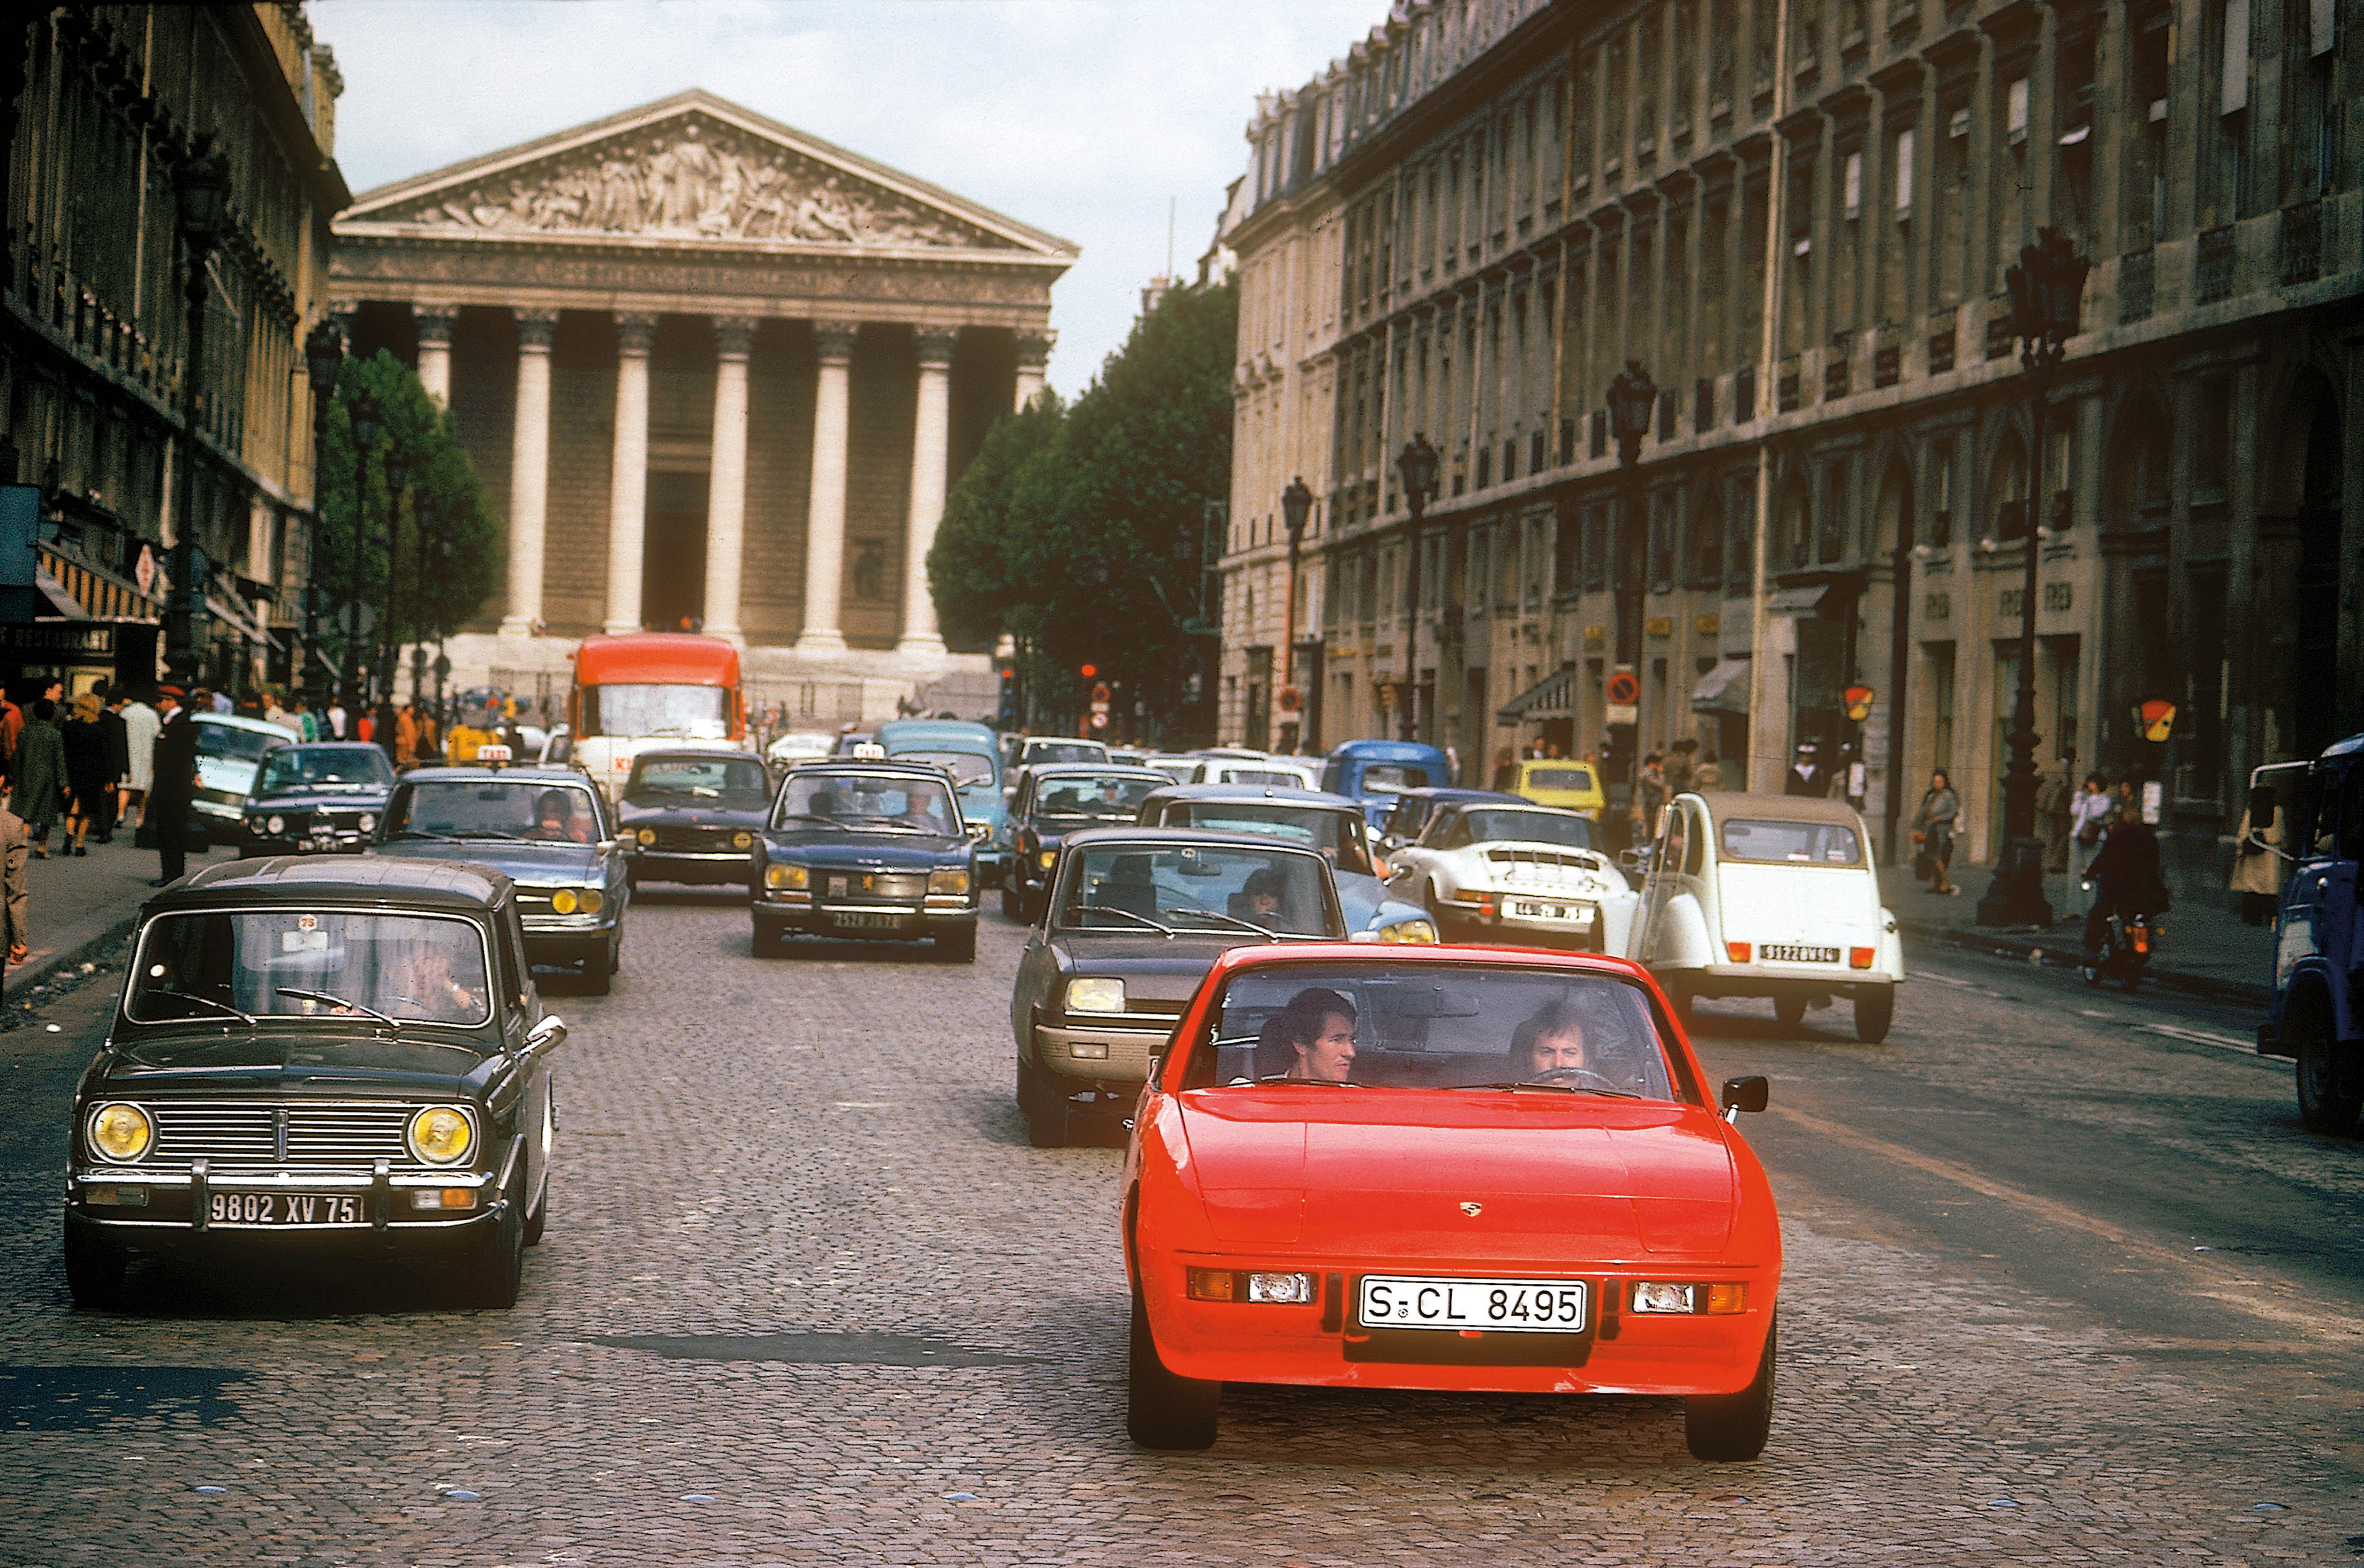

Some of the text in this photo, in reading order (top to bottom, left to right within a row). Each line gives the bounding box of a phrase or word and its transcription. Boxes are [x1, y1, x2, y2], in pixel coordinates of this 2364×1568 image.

[483, 749, 507, 759] TAXI
[302, 918, 315, 927] 75
[212, 1194, 354, 1222] 9802 XV 75
[1488, 1289, 1576, 1322] 8495
